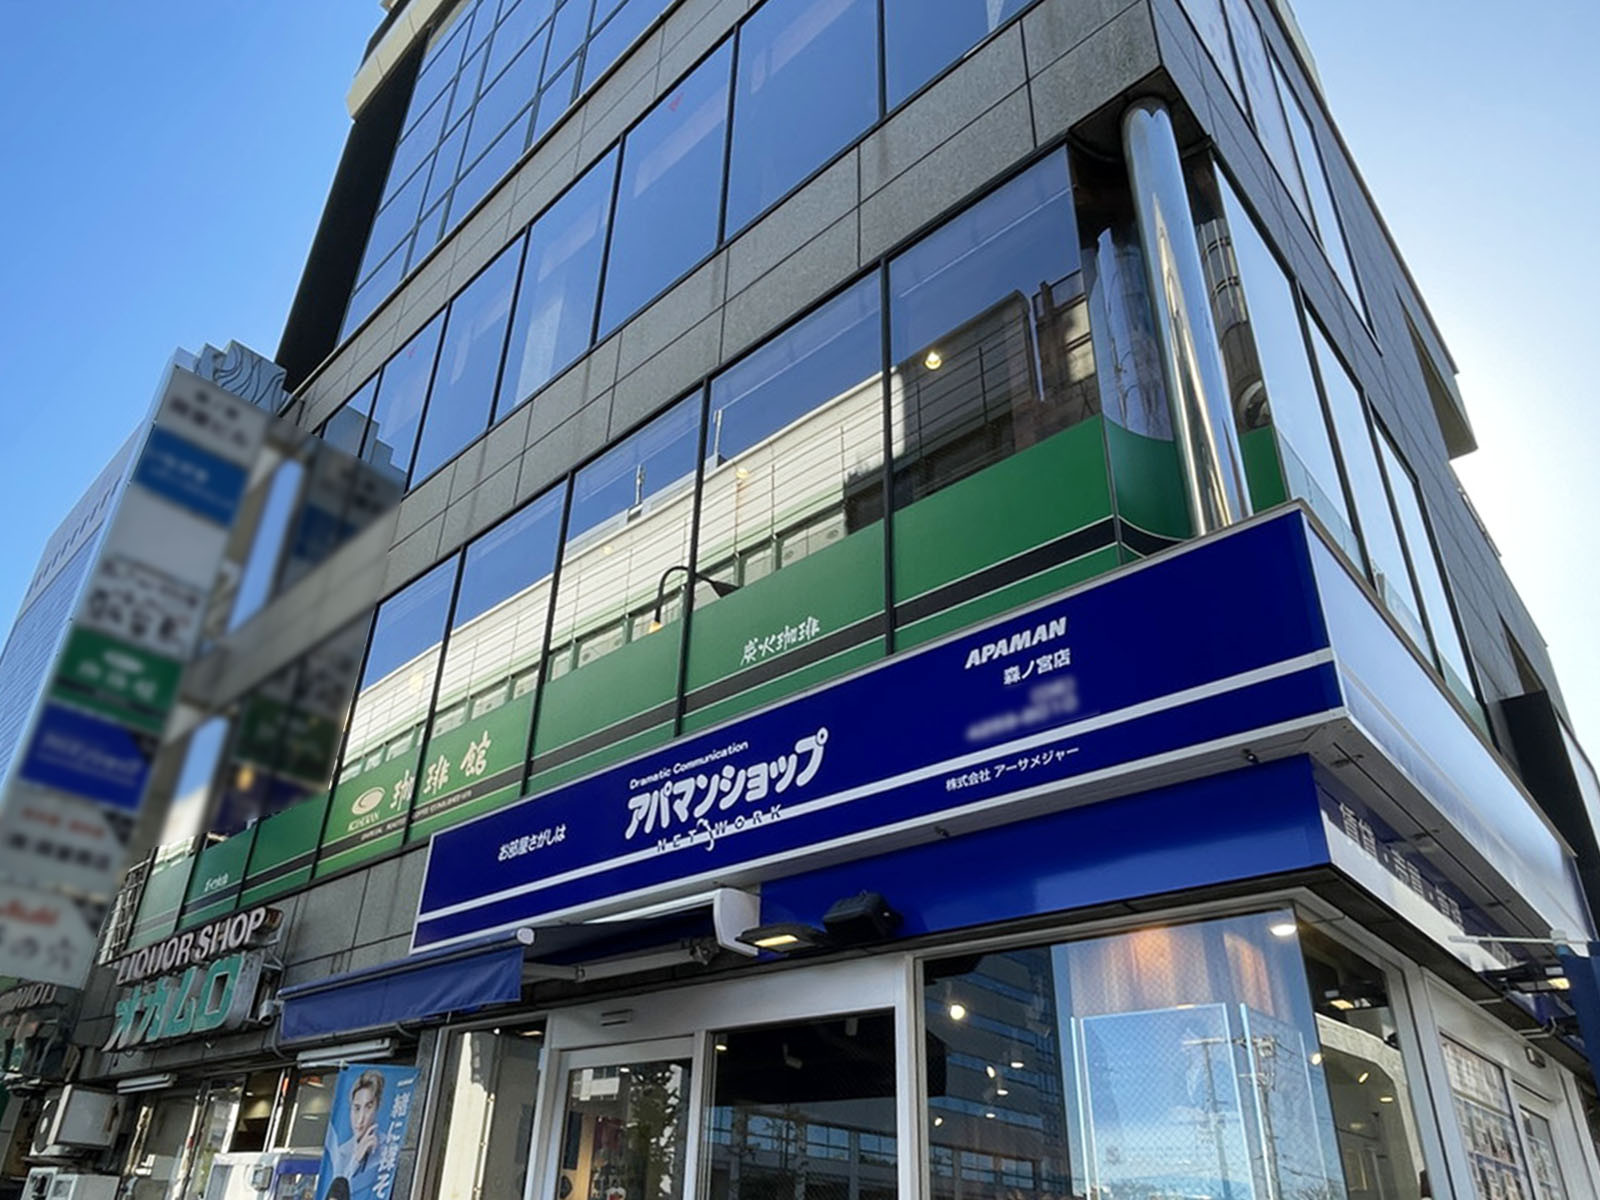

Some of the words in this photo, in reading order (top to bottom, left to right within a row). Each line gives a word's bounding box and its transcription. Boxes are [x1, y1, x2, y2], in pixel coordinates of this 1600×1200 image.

[965, 617, 1067, 670] APAMAN
[1003, 648, 1071, 685] 森ノ宮店
[390, 730, 492, 811] 珈琲館
[625, 727, 829, 840] アパマンショップ
[630, 766, 672, 790] Dramatic
[673, 741, 749, 774] Communication
[946, 768, 991, 792] 株式会社
[994, 747, 1079, 778] アーサメジャー
[498, 823, 566, 861] お部屋さがしは
[657, 803, 782, 852] NETWORK
[116, 931, 194, 986] LIQUOR
[195, 907, 266, 961] SHOP
